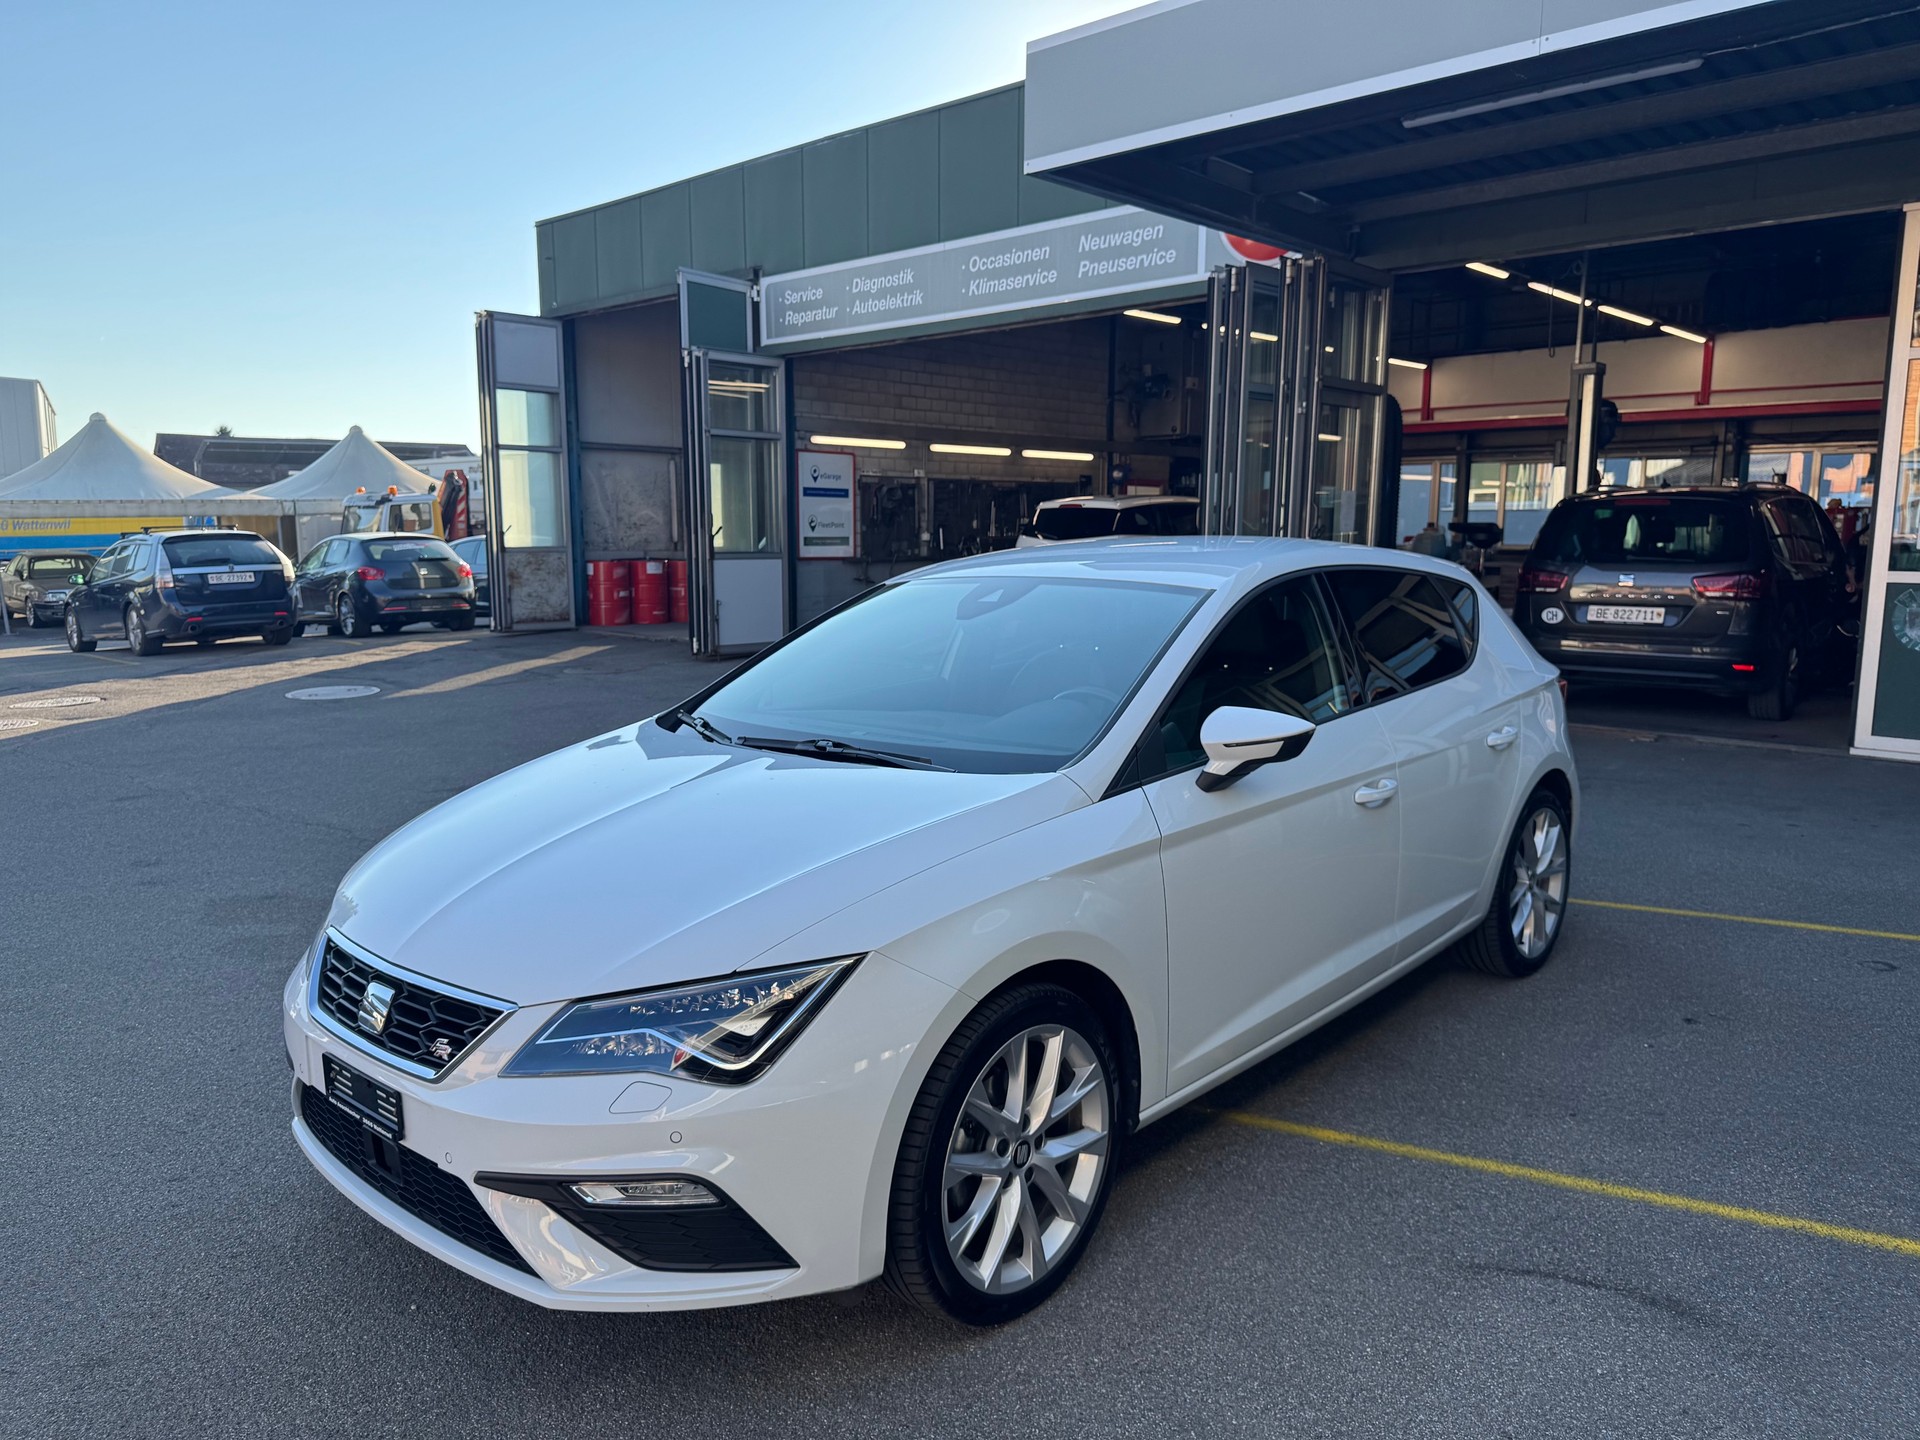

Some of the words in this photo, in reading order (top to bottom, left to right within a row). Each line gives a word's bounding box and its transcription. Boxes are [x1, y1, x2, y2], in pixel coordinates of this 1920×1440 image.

[1078, 224, 1164, 253] Neuwagen
[969, 246, 1050, 272] Occasionen
[1078, 248, 1176, 278] Pneuservice
[852, 268, 914, 293] Diagnostik
[969, 269, 1057, 296] Klimaservice
[784, 286, 823, 304] Service
[852, 290, 923, 315] Autoelektrik
[785, 305, 838, 326] Reparatur
[12, 519, 71, 531] Wattenwil
[1546, 611, 1558, 621] CH
